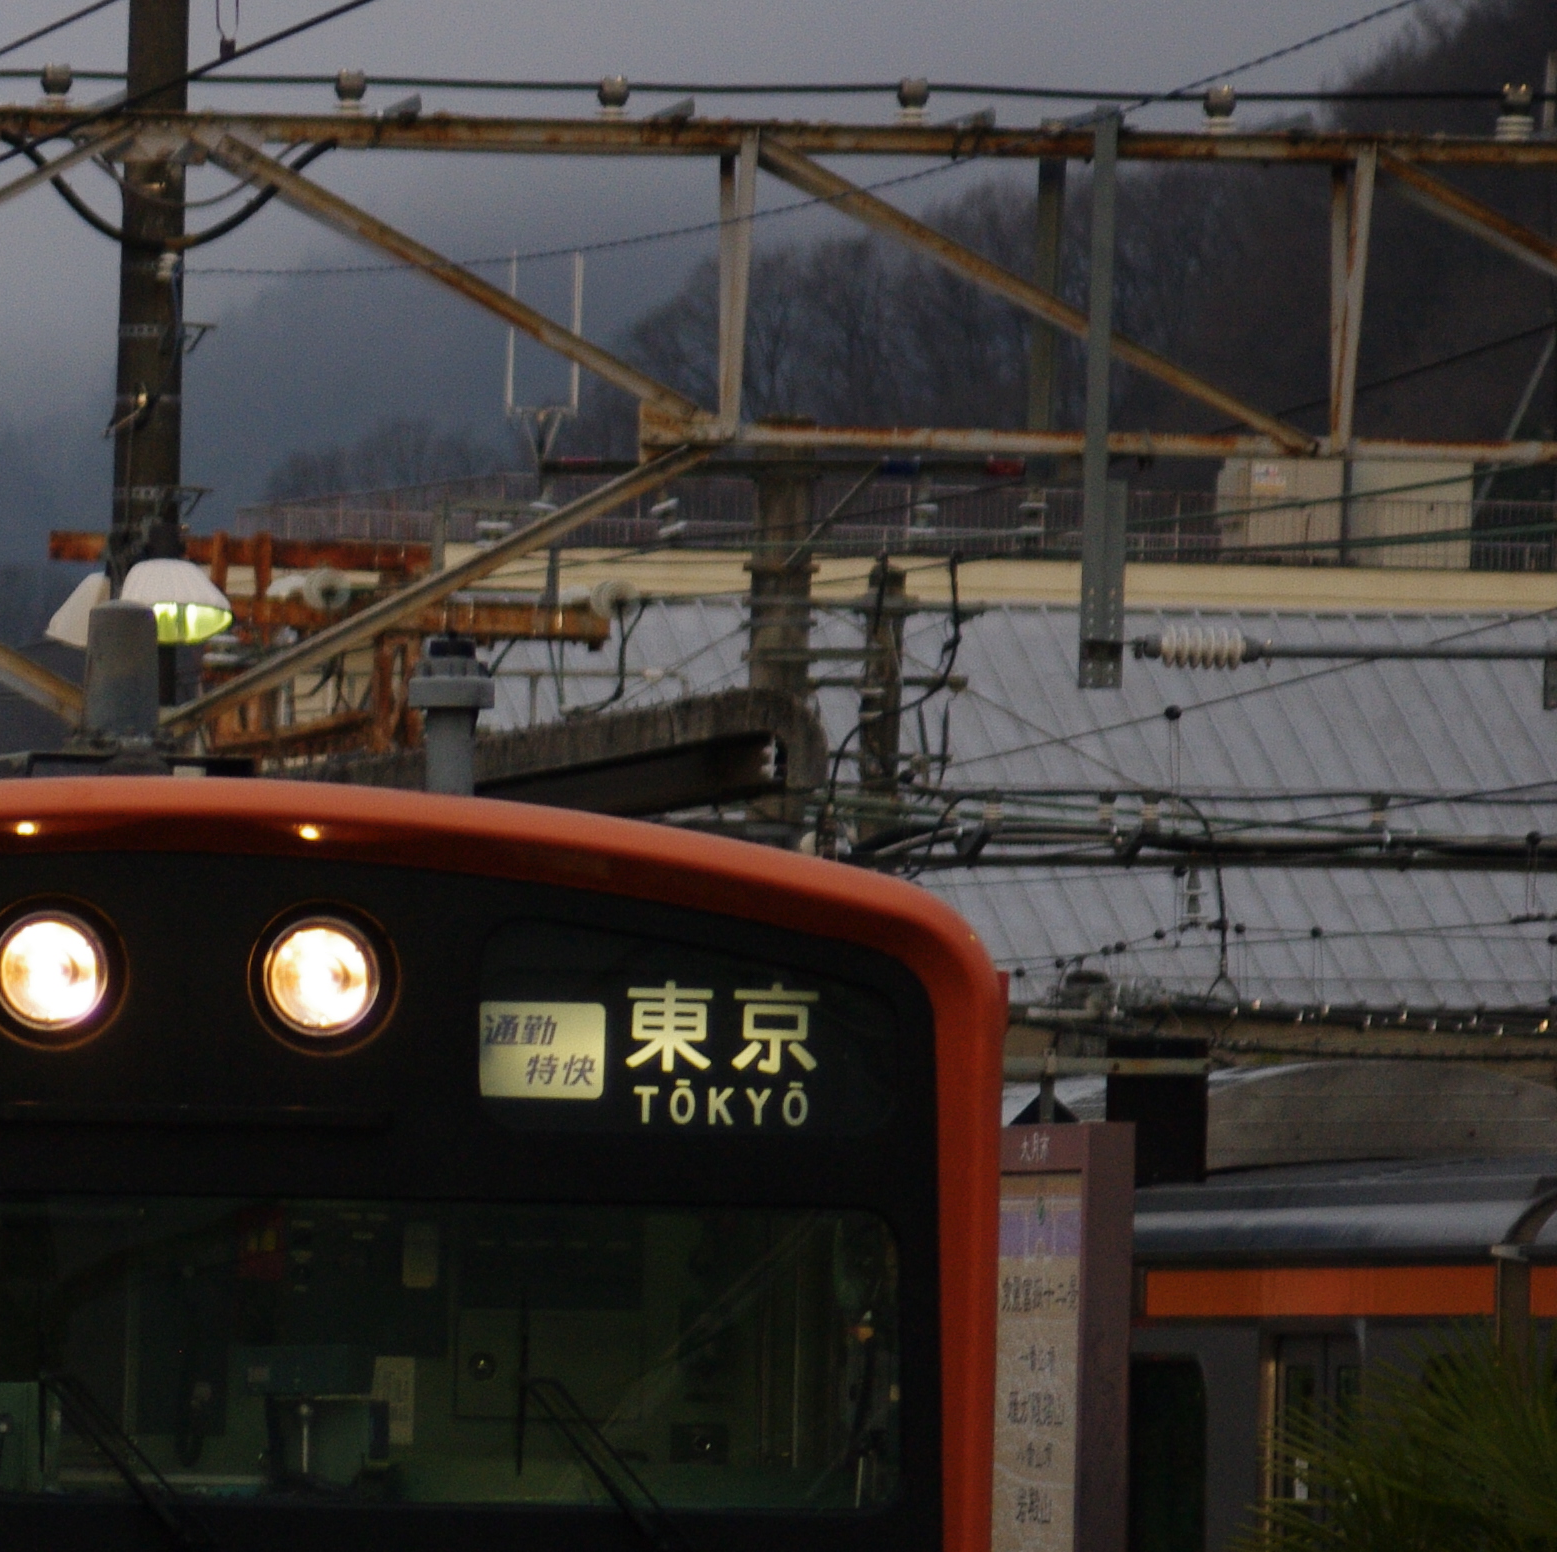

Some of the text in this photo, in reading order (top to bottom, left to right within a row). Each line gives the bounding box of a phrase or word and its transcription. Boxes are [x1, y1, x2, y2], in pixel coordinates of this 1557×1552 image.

[484, 1013, 558, 1047] 通勤
[625, 980, 820, 1074] 東京
[525, 1053, 596, 1088] 特快
